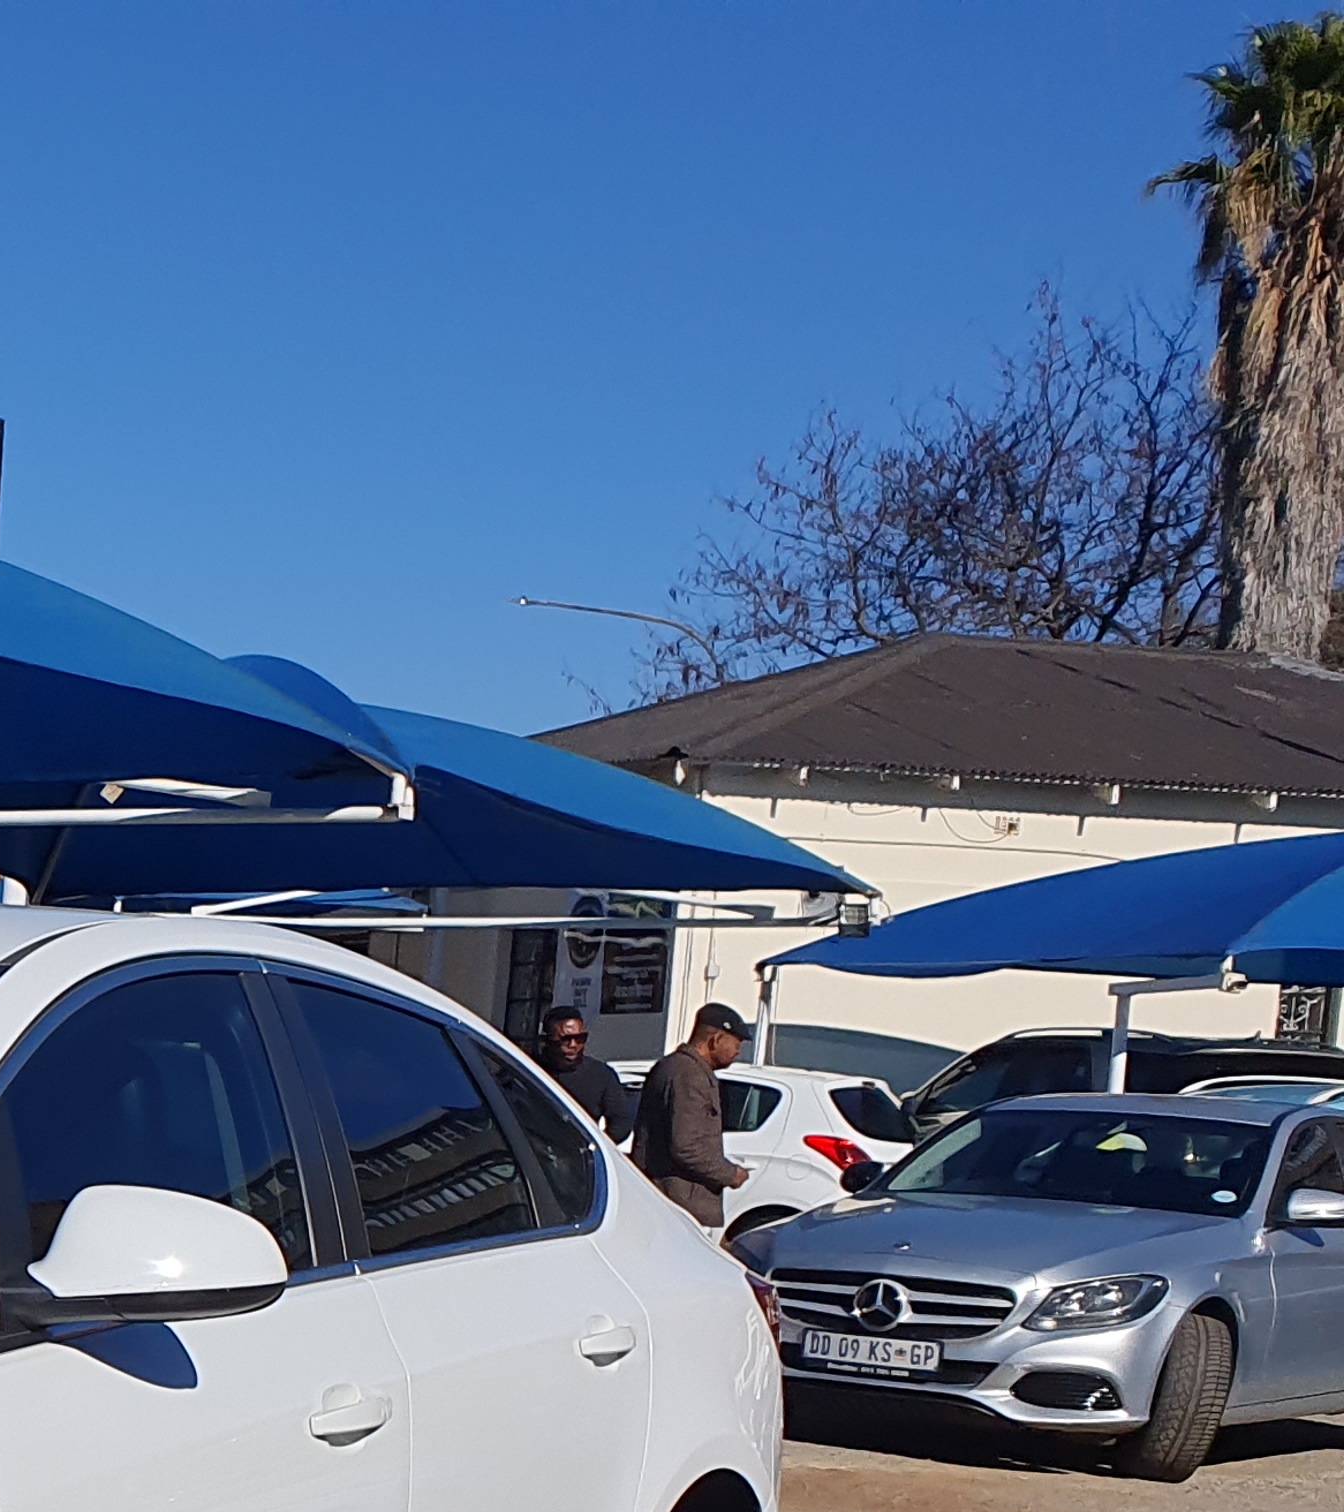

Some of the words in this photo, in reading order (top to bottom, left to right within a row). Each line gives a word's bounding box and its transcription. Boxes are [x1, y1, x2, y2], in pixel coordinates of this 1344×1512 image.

[809, 1334, 831, 1355] DD
[838, 1337, 860, 1358] 09
[868, 1340, 892, 1362] KS
[910, 1344, 934, 1366] GP
